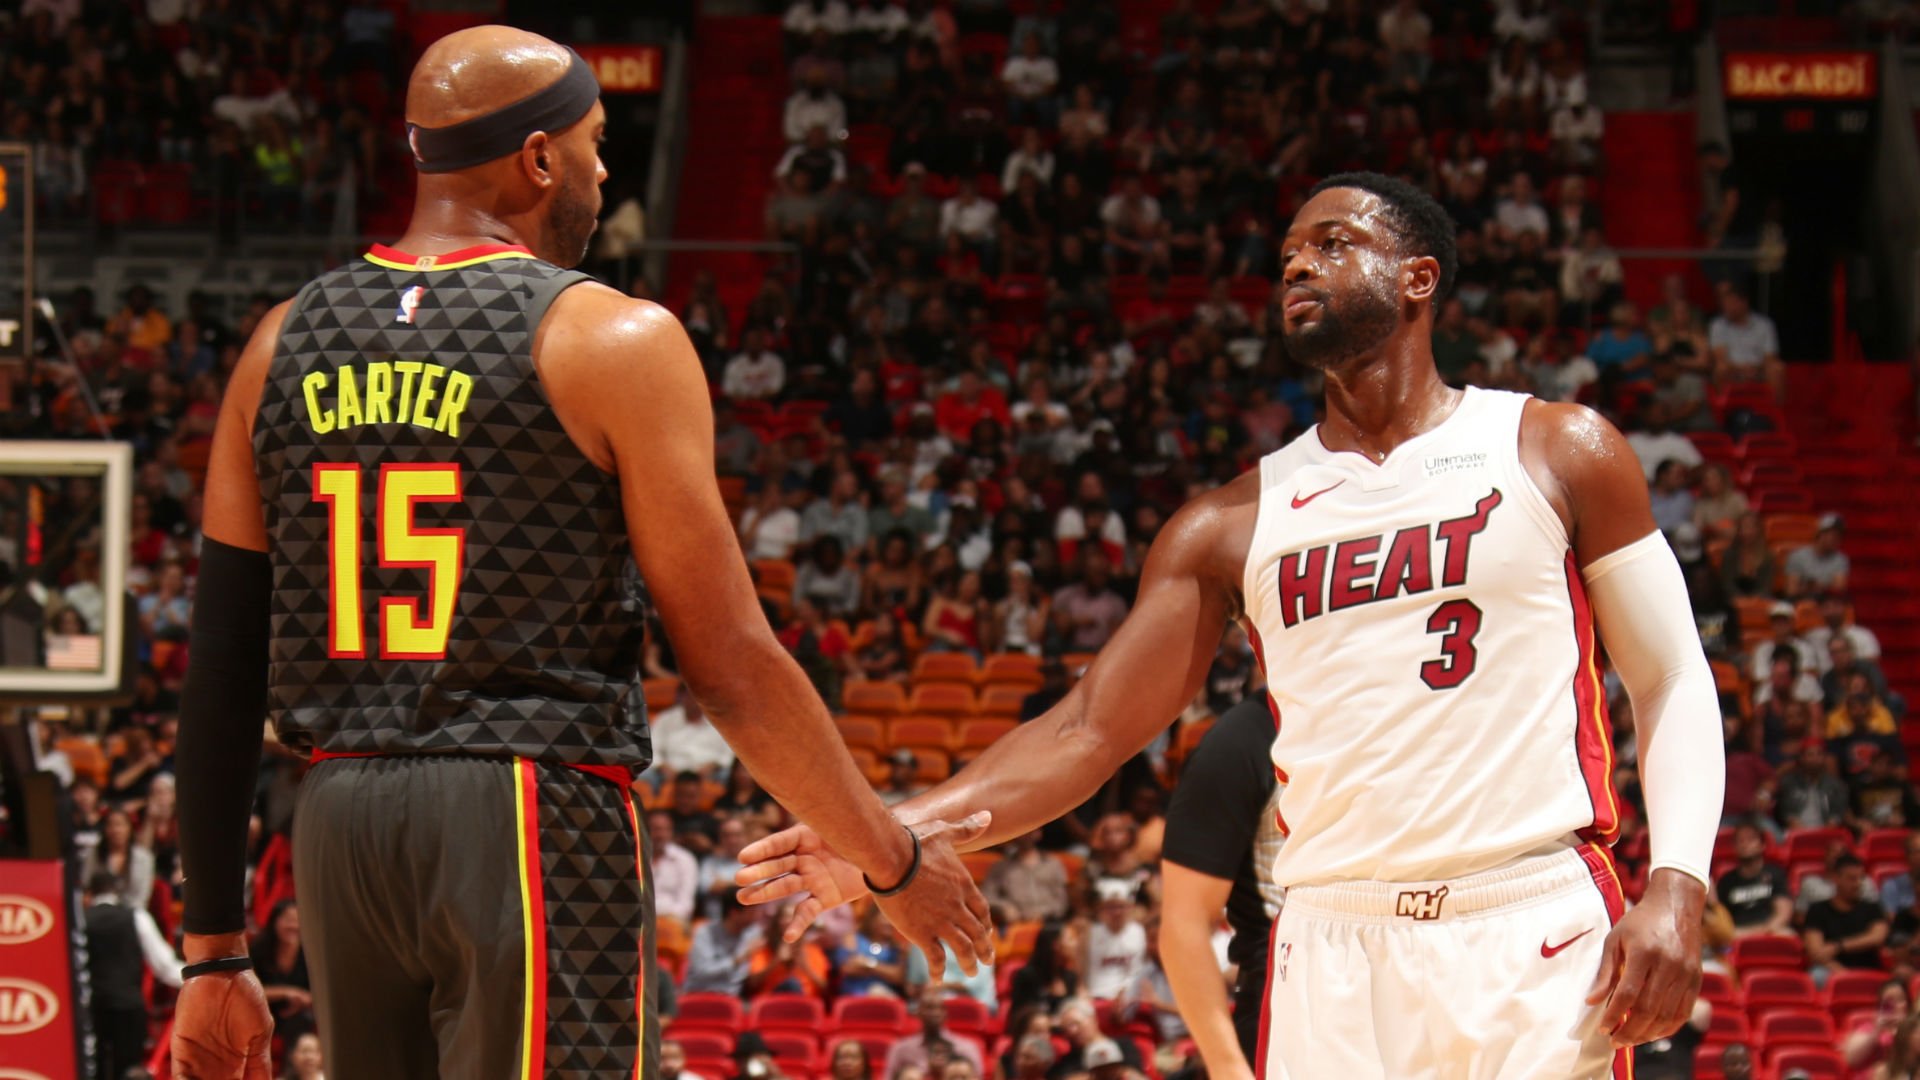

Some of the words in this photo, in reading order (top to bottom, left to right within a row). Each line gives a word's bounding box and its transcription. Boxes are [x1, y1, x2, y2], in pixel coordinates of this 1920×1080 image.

[1729, 55, 1867, 96] BACARDÍ
[302, 361, 474, 438] CARTER
[1424, 453, 1487, 470] Ultimate
[312, 462, 465, 660] 15
[1278, 487, 1503, 629] HEAT
[1420, 598, 1483, 691] 3
[0, 907, 37, 936] IA
[1396, 885, 1449, 920] MH
